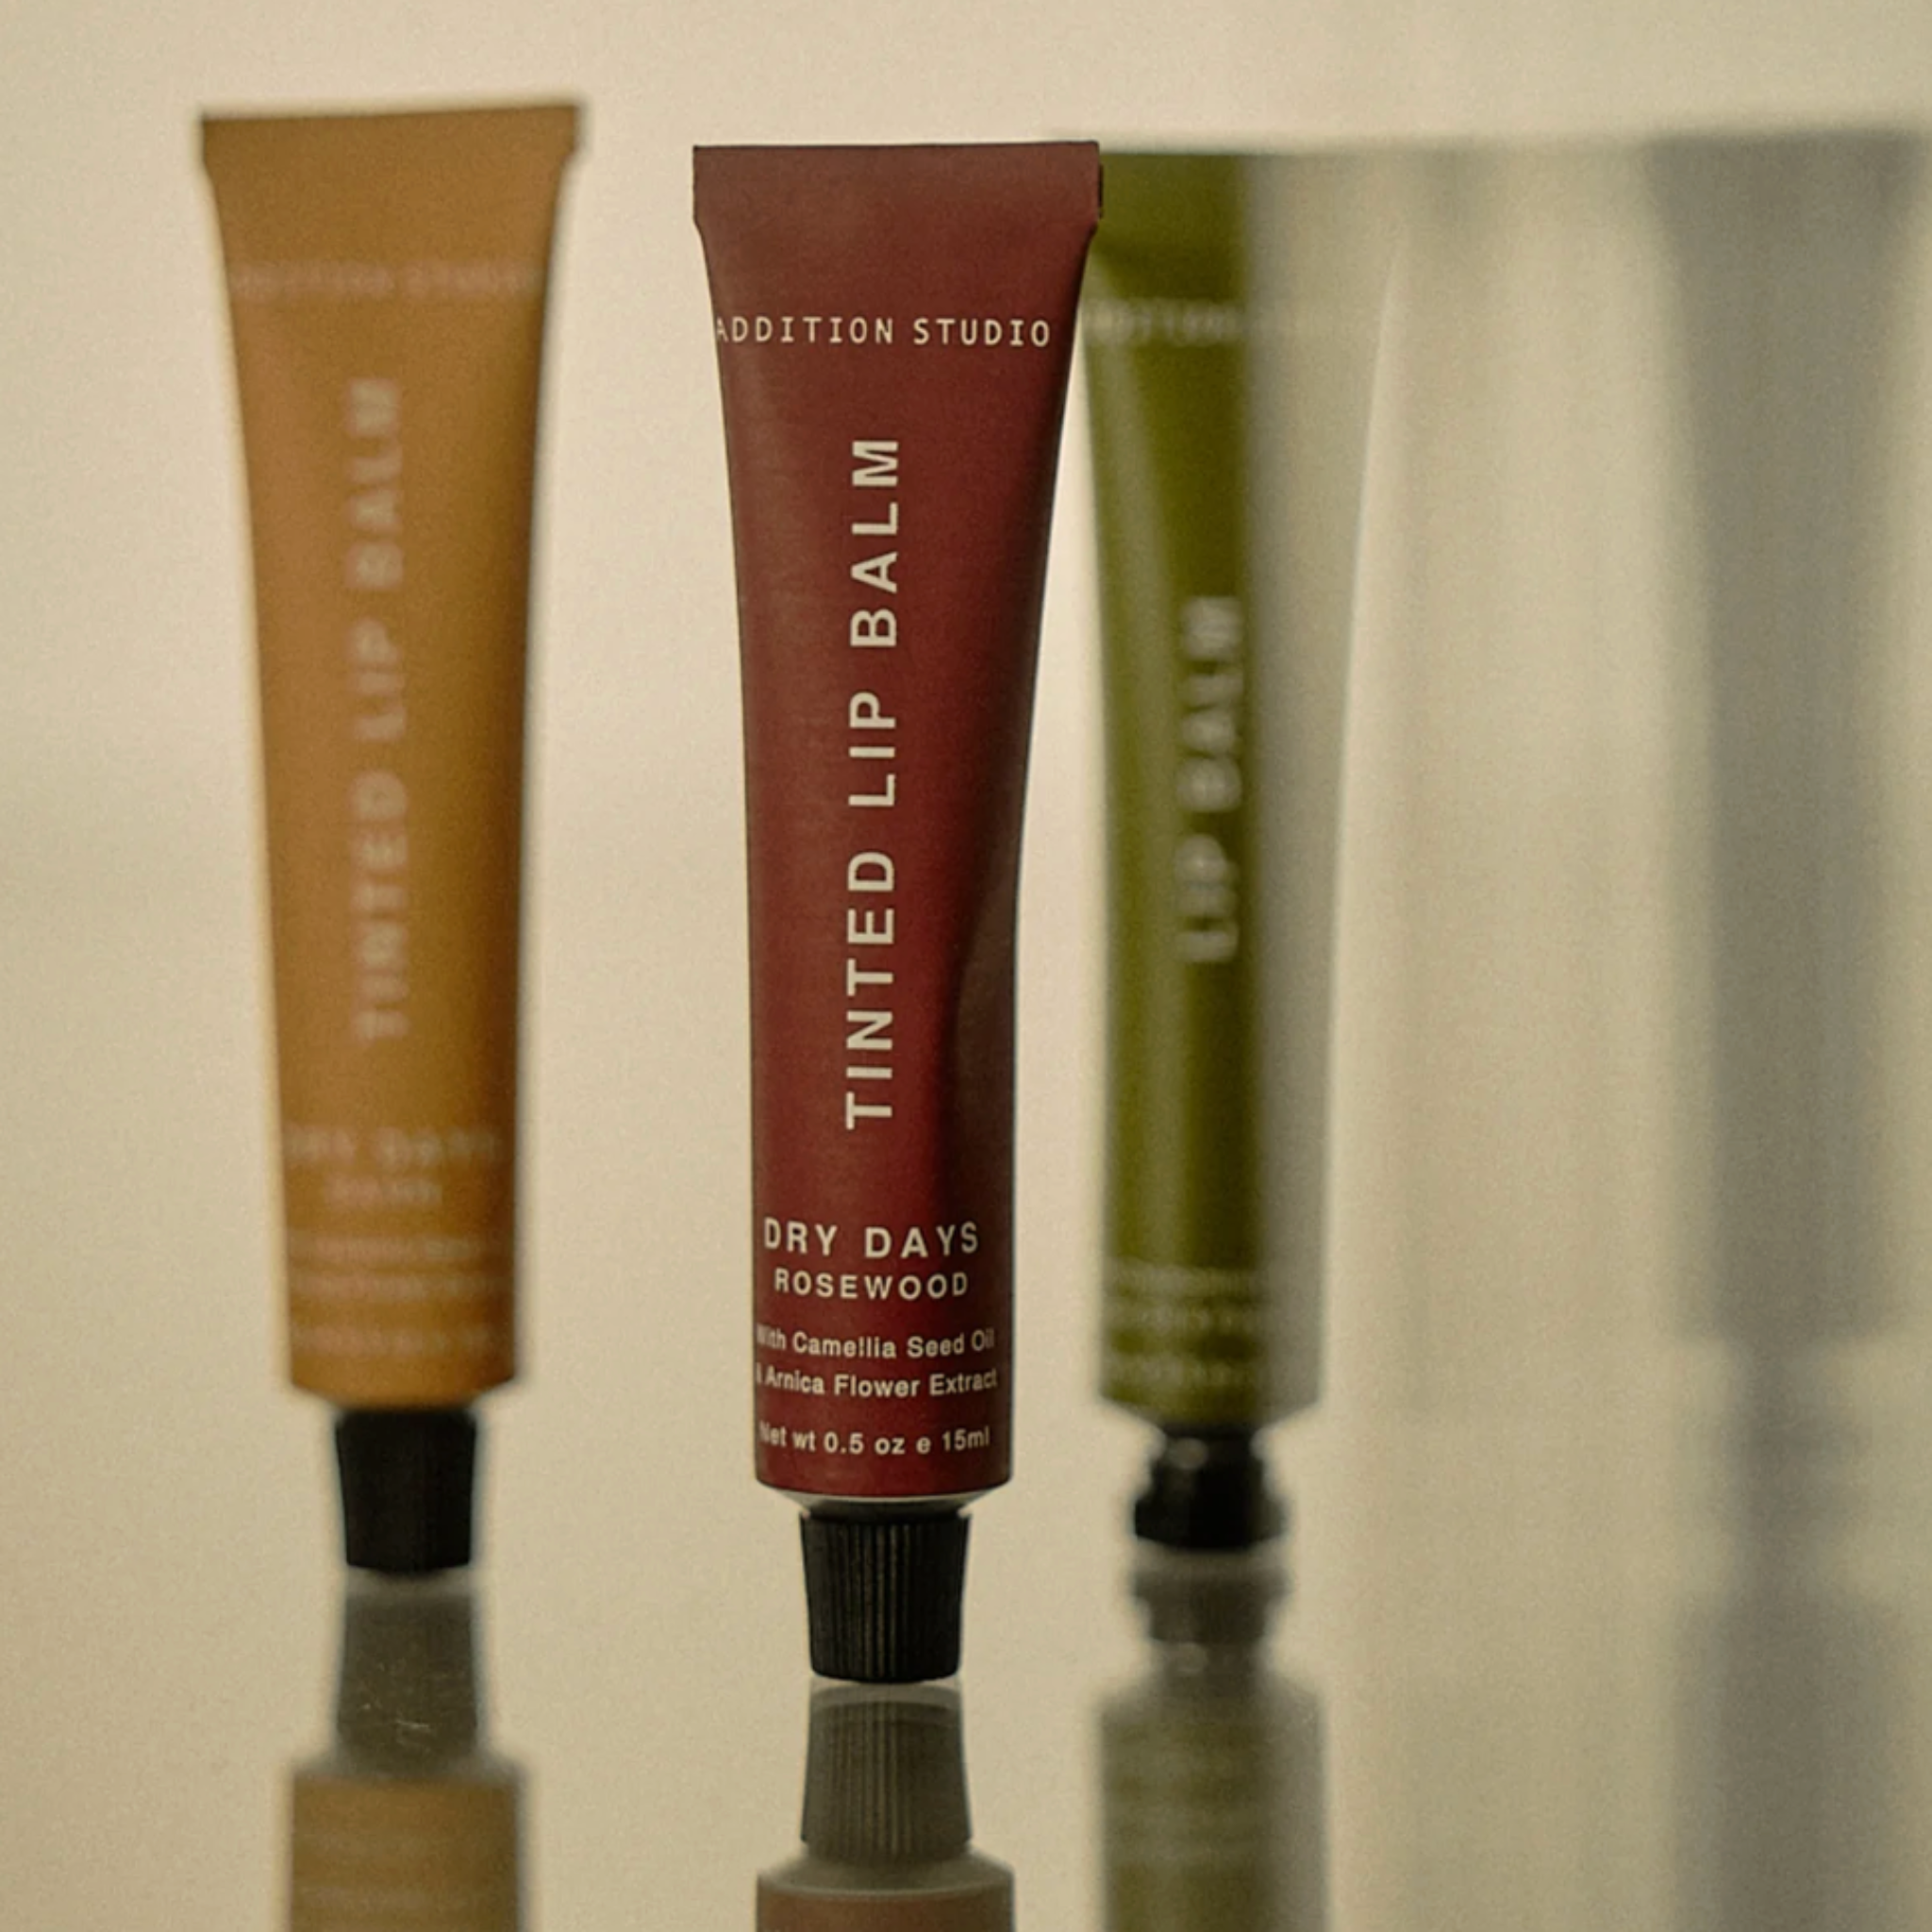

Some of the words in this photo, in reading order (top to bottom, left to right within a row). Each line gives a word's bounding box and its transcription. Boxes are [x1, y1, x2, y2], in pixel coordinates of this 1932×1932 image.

[913, 317, 1051, 347] STUDIO
[851, 439, 900, 649] BALM
[848, 691, 898, 808] LIP
[845, 850, 896, 1131] TINTED
[764, 1217, 838, 1257] DRY
[864, 1221, 979, 1259] DAYS
[774, 1268, 968, 1301] ROSEWOOD
[791, 1329, 898, 1359] Camellia
[906, 1332, 966, 1358] Seed
[971, 1326, 996, 1352] Oil
[765, 1363, 826, 1396] Arnica
[833, 1372, 922, 1398] Flower
[928, 1367, 998, 1396] Extract
[791, 1429, 817, 1454] wt
[823, 1430, 865, 1455] 0.5
[874, 1435, 907, 1456] oz
[942, 1424, 991, 1452] 15ml
